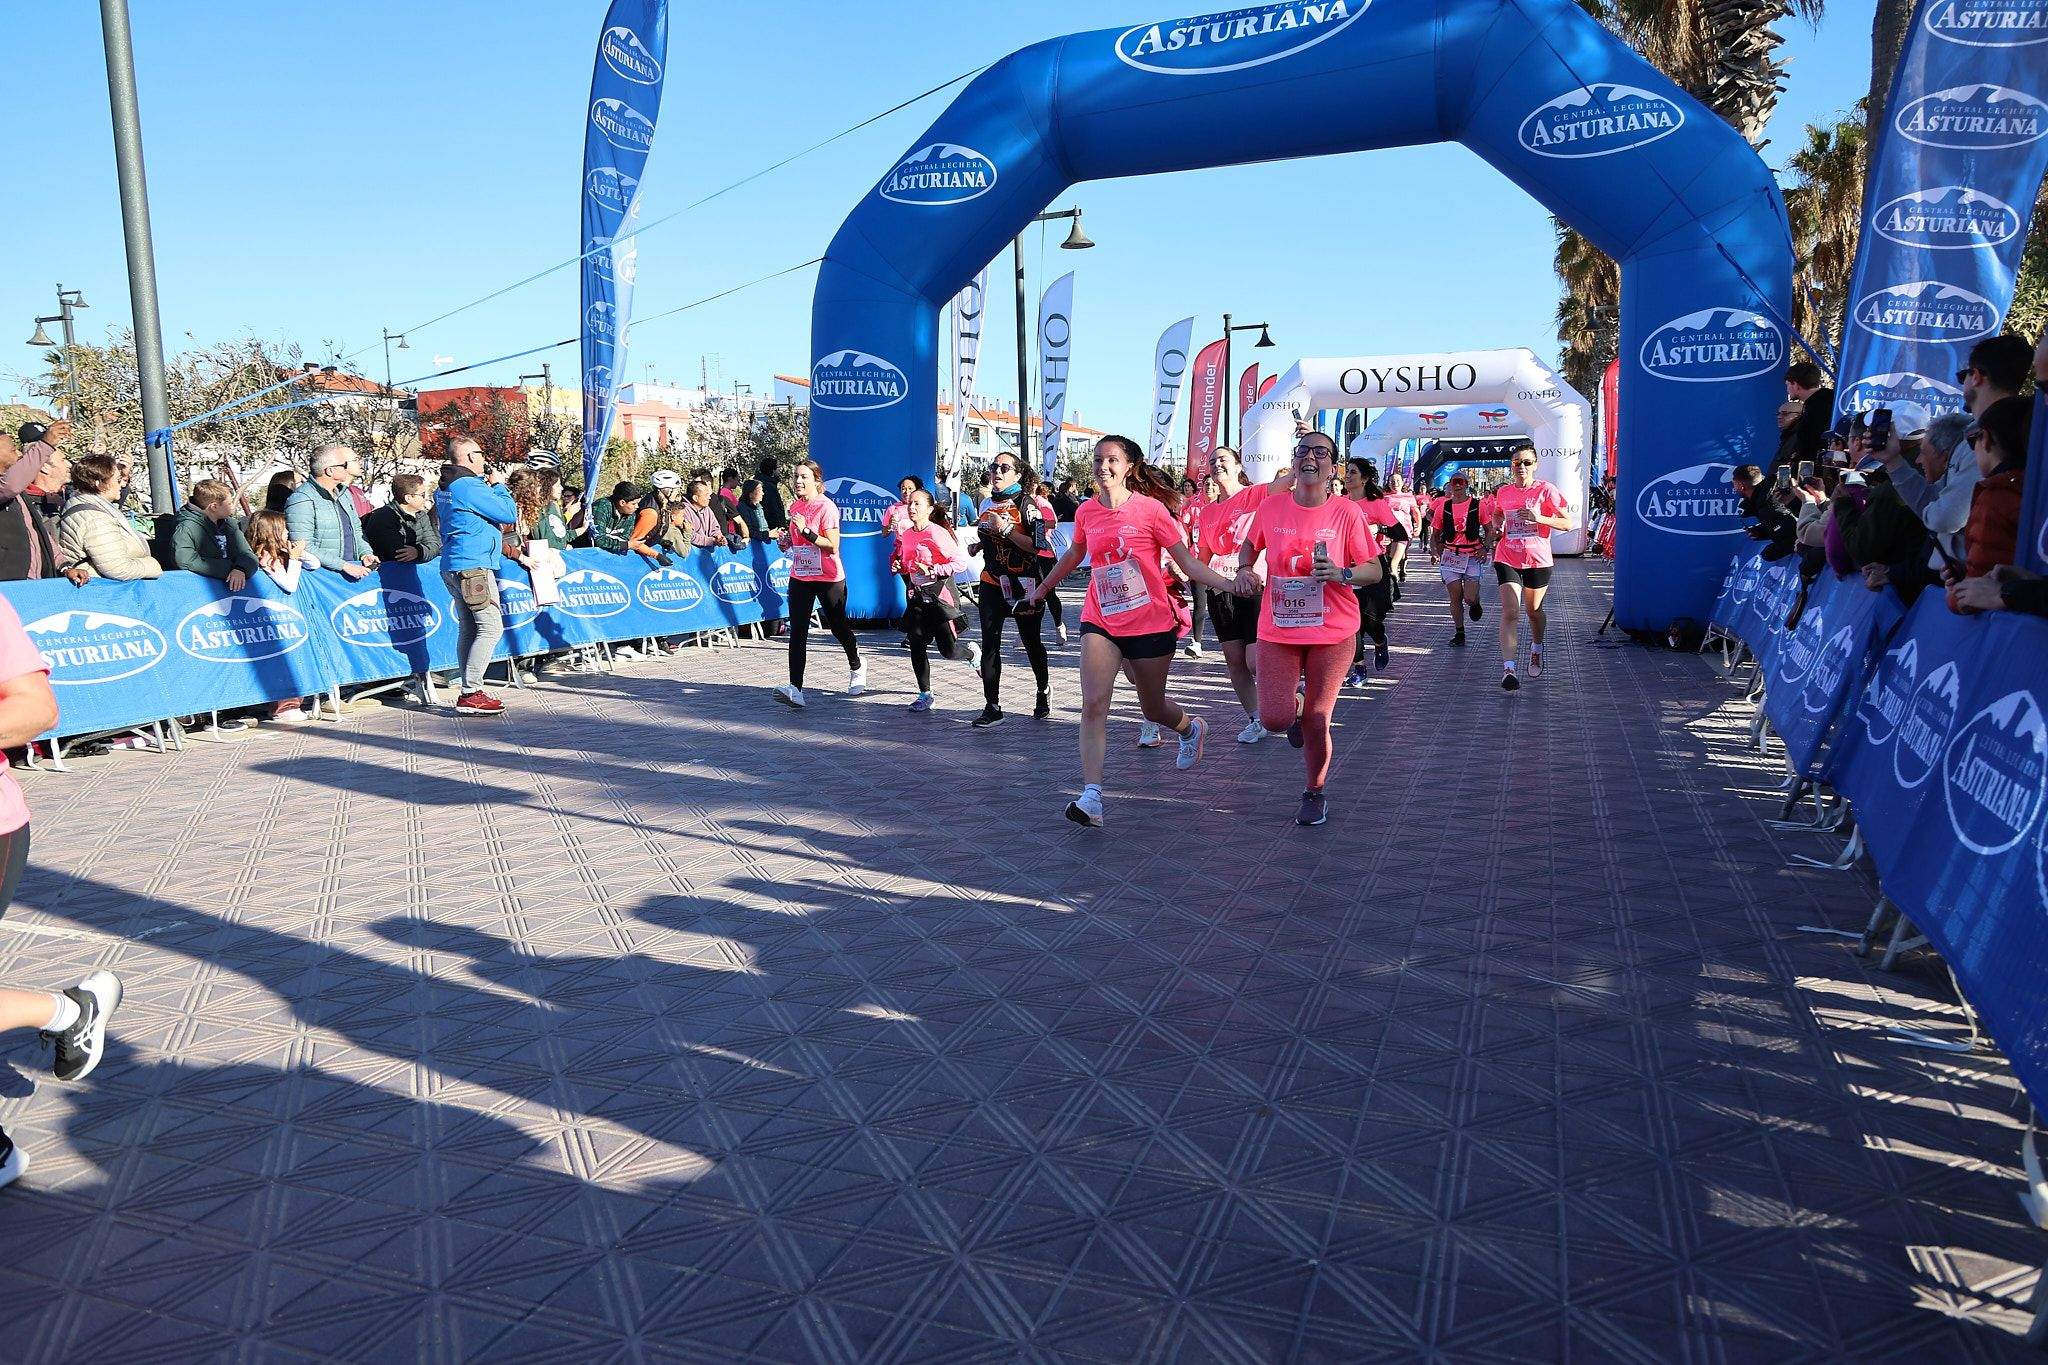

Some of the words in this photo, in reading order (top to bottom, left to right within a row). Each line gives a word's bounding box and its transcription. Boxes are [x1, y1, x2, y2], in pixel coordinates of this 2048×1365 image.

[1132, 0, 1350, 57] ASTURIANA
[604, 35, 655, 80] ASTURIANA
[1613, 102, 1666, 113] LECHERA
[1934, 105, 1982, 115] CENTRAL
[1987, 106, 2039, 115] LECHERA
[1531, 111, 1674, 147] ASTURIANA
[1905, 107, 2038, 135] ASTURIANA
[904, 163, 938, 174] CENTRAL
[941, 161, 983, 169] LECHERA
[884, 171, 987, 193] ASTURIANA
[1882, 207, 2005, 237] ASTURIANA
[1909, 206, 1955, 214] CENTRAL
[1959, 206, 2006, 220] LECHERA
[1888, 300, 1933, 309] CENTRAL
[1937, 303, 1985, 312] LECHERA
[1863, 301, 1985, 331] ASTURIANA
[1671, 333, 1725, 343] CENTRAL
[1729, 331, 1775, 340] LECHERA
[1649, 340, 1777, 367] ASTURIANA
[856, 371, 896, 379] LECHERA
[1340, 363, 1476, 394] OYSHO
[813, 374, 900, 397] ASTURIANA
[1517, 389, 1562, 400] OYSHO
[1200, 362, 1216, 434] Santander
[1262, 401, 1301, 410] OYSHO
[1452, 445, 1517, 454] VOLVO
[1667, 488, 1718, 497] CENTRAL
[853, 498, 893, 507] LECHERA
[643, 584, 700, 602] ASTURIANA
[717, 578, 759, 595] ASTURIANA
[1111, 584, 1130, 594] 016
[559, 589, 628, 608] ASTURIANA
[1284, 598, 1306, 608] 016
[205, 618, 248, 629] CENTRAL
[342, 612, 437, 637] ASTURIANA
[36, 635, 90, 647] CENTRAL
[93, 628, 148, 642] LECHERA
[190, 622, 302, 651] ASTURIANA
[39, 638, 159, 669] STURIANA
[1950, 733, 2032, 832] ASTURIANA
